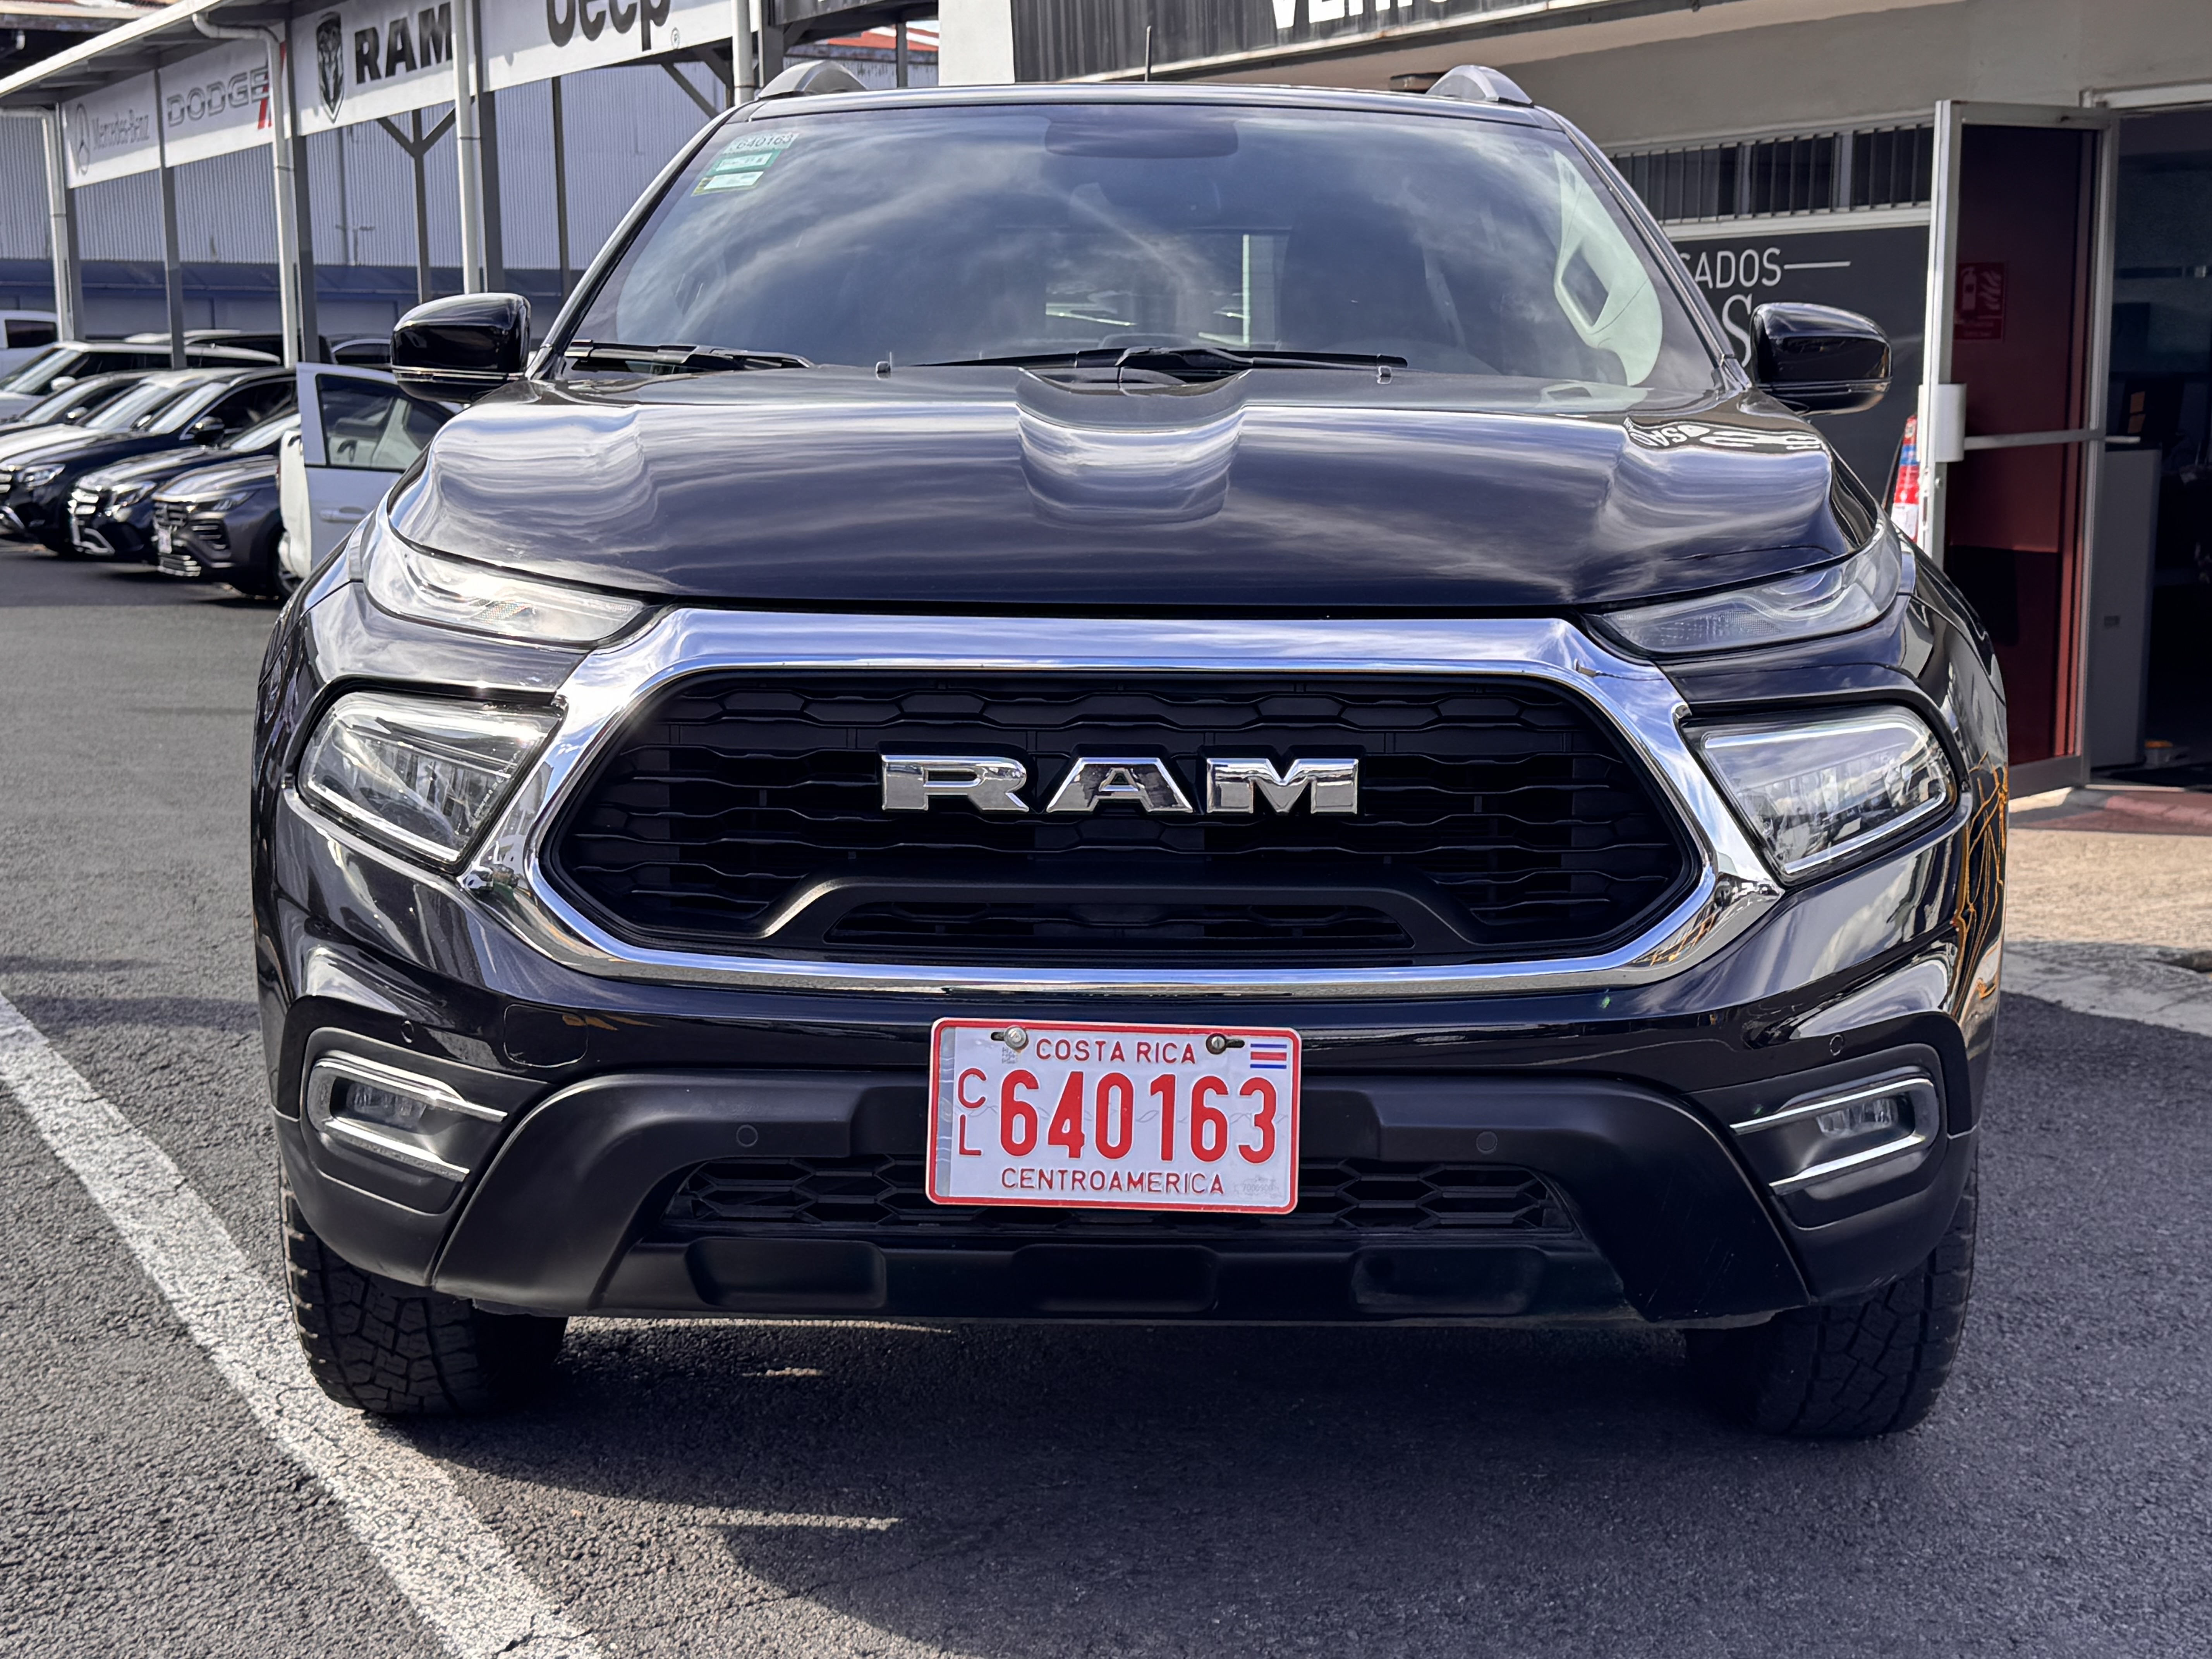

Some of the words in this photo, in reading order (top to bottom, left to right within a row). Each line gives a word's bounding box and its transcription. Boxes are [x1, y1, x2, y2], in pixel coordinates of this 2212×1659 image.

[355, 1, 452, 84] RAM
[167, 66, 270, 127] DODGE
[737, 133, 794, 149] 640163
[881, 754, 1359, 815] RAM
[1036, 1038, 1126, 1063] COSTA
[1136, 1042, 1196, 1064] RICA
[1000, 1069, 1277, 1164] 640163
[1001, 1168, 1224, 1195] CENTROAMERICA
